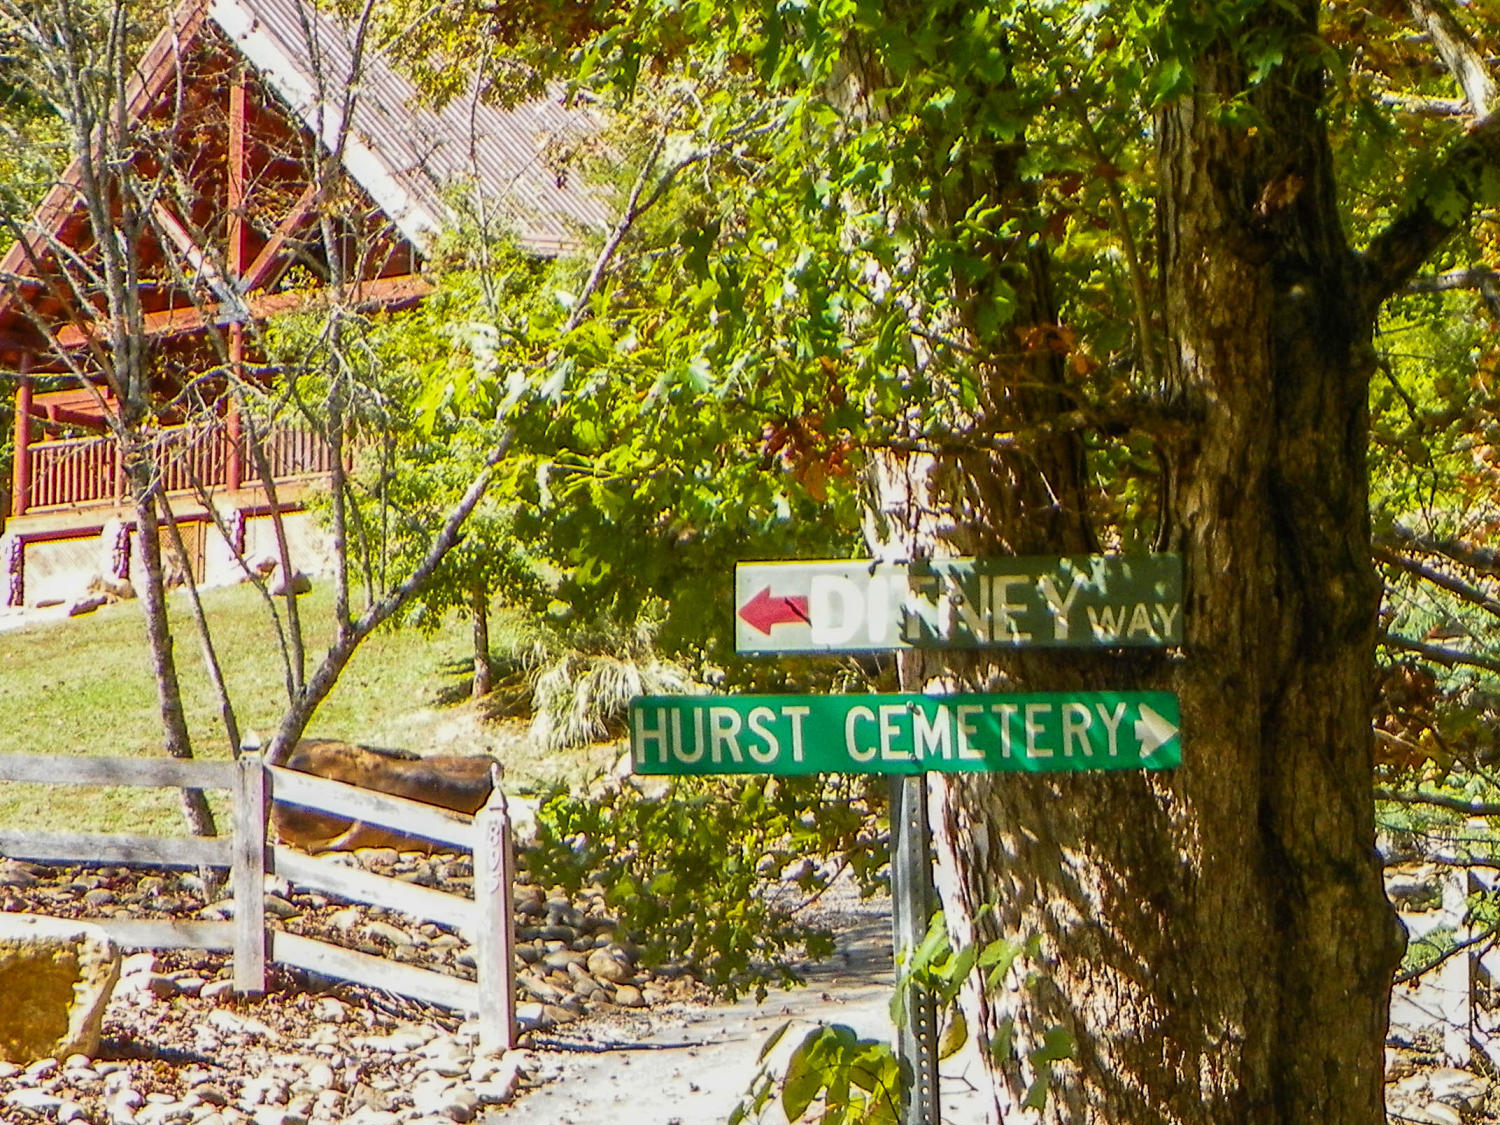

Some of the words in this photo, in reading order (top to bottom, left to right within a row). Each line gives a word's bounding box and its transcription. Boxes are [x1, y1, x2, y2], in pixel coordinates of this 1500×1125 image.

[810, 573, 1089, 645] DITNEY
[1086, 602, 1181, 642] WAY
[634, 705, 810, 764] HURST
[845, 701, 1127, 762] CEMETERY
